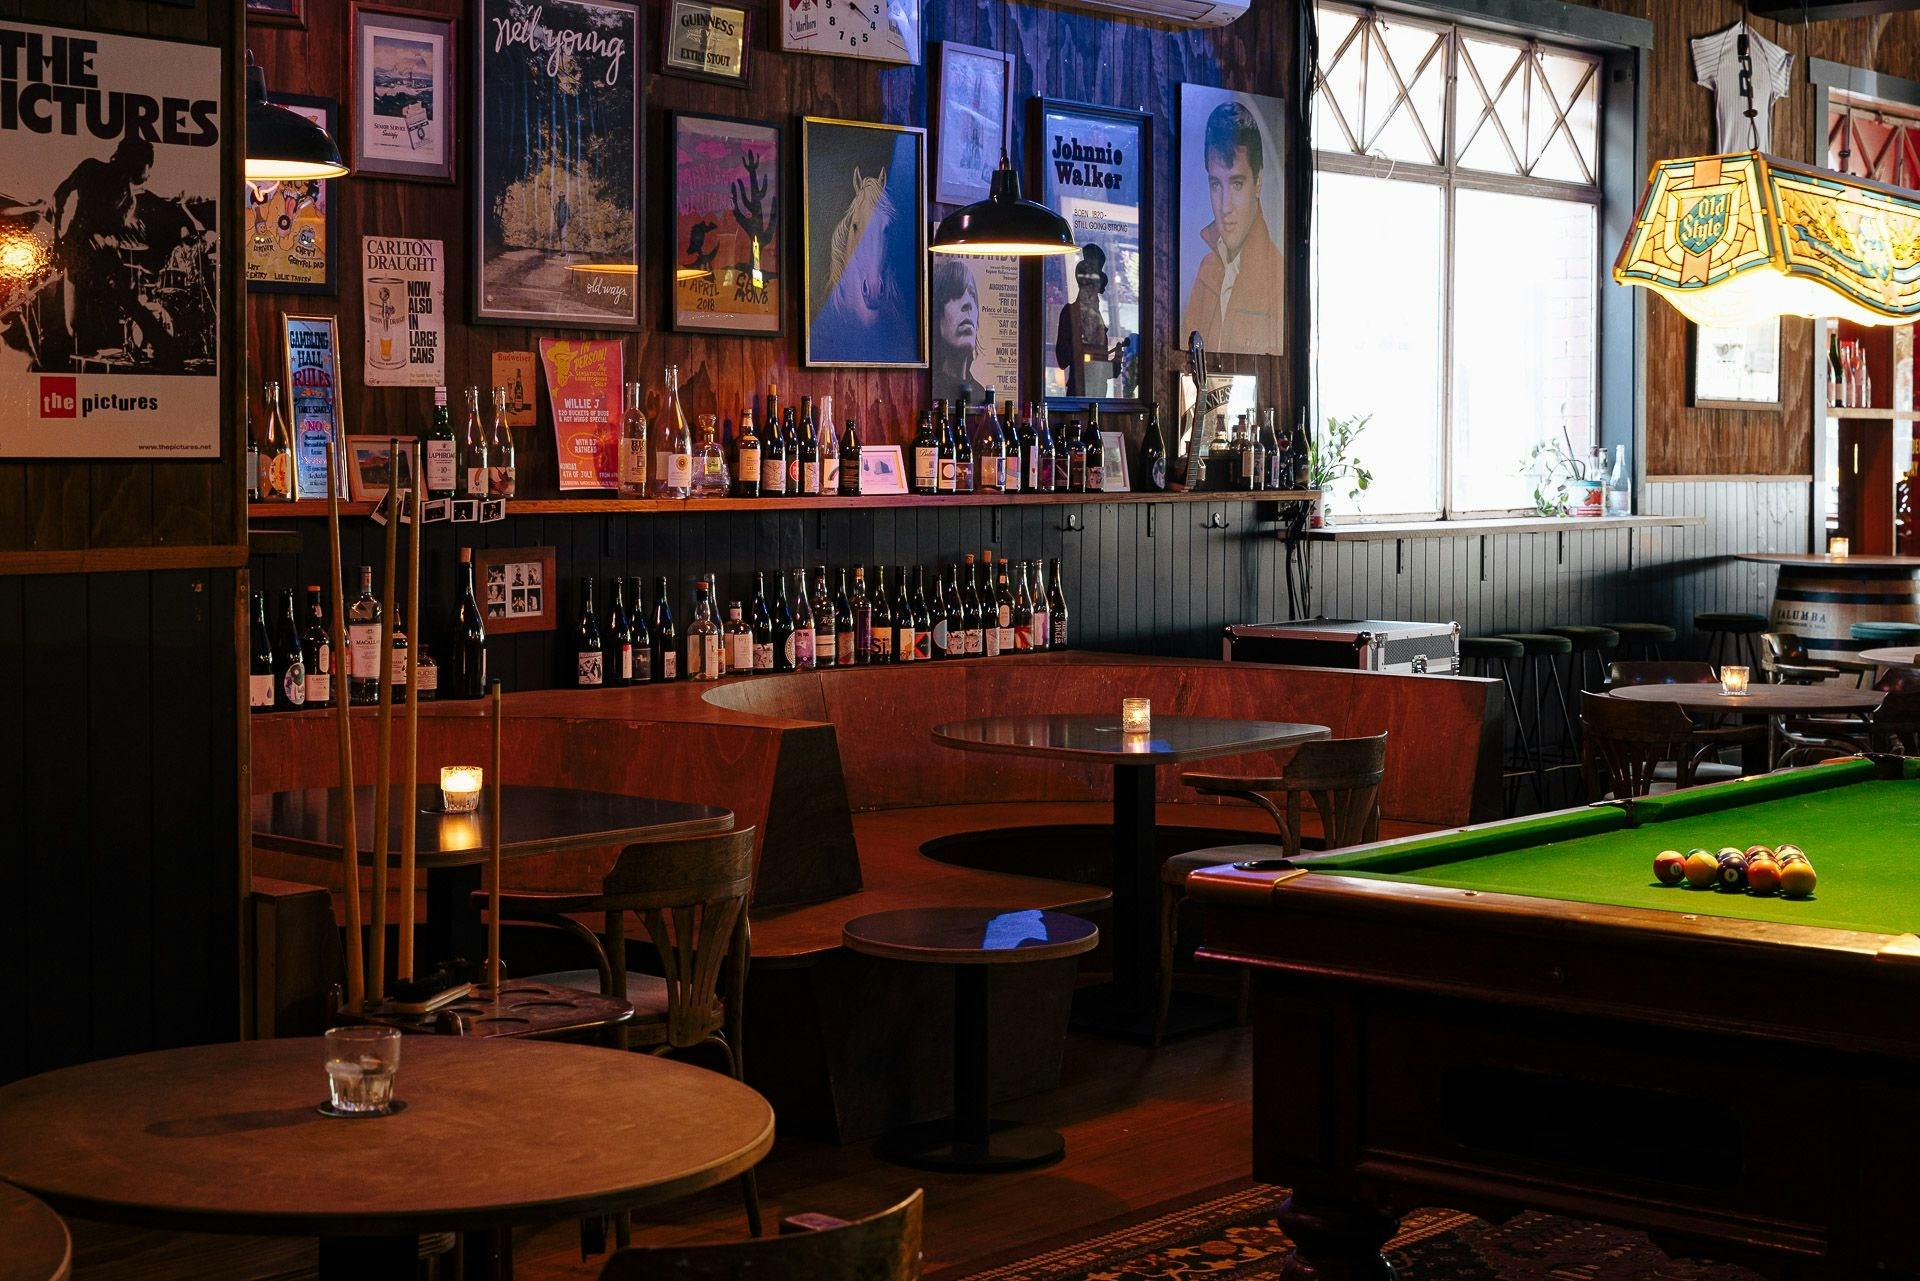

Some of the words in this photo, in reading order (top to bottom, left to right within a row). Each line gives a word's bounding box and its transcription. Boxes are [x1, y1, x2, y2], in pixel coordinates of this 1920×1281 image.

[825, 0, 833, 9] 9
[873, 5, 880, 14] 3
[681, 13, 735, 36] GUINNESS
[795, 15, 818, 33] Marlboro
[829, 16, 836, 26] 8
[870, 21, 877, 30] 4
[492, 5, 542, 53] neil
[547, 29, 626, 86] young
[839, 31, 845, 40] 7
[850, 37, 857, 46] 6
[862, 33, 869, 43] 5
[0, 28, 98, 88] THE
[706, 52, 731, 67] STOUT
[1, 80, 219, 148] ICTURES
[1052, 135, 1123, 166] Johnnie
[1054, 160, 1123, 190] Walker
[1698, 195, 1725, 218] Old
[1074, 219, 1089, 231] STILL
[1089, 221, 1107, 232] GOING
[1107, 222, 1128, 233] STRONG
[1681, 213, 1721, 246] Style
[367, 240, 433, 257] CARLTON
[367, 255, 438, 272] DRAUGHT
[407, 281, 431, 298] NOW
[602, 285, 627, 305] ways
[690, 279, 720, 298] APRIL
[408, 298, 432, 314] ALSO
[696, 297, 716, 312] 2018
[982, 305, 996, 313] Prince
[409, 314, 419, 330] IN
[290, 330, 328, 350] GAMBLING
[410, 331, 438, 347] LARGE
[297, 351, 324, 369] HALL
[410, 348, 434, 364] CANS
[498, 353, 531, 362] Budweiser
[996, 347, 1009, 356] MON
[1010, 348, 1017, 356] 04
[293, 368, 331, 387] RULES
[43, 392, 75, 413] the
[81, 393, 158, 417] pictures
[564, 398, 592, 409] WILLIE
[594, 398, 600, 409] J
[308, 421, 321, 432] NO
[138, 443, 212, 451] www.thepictures.net
